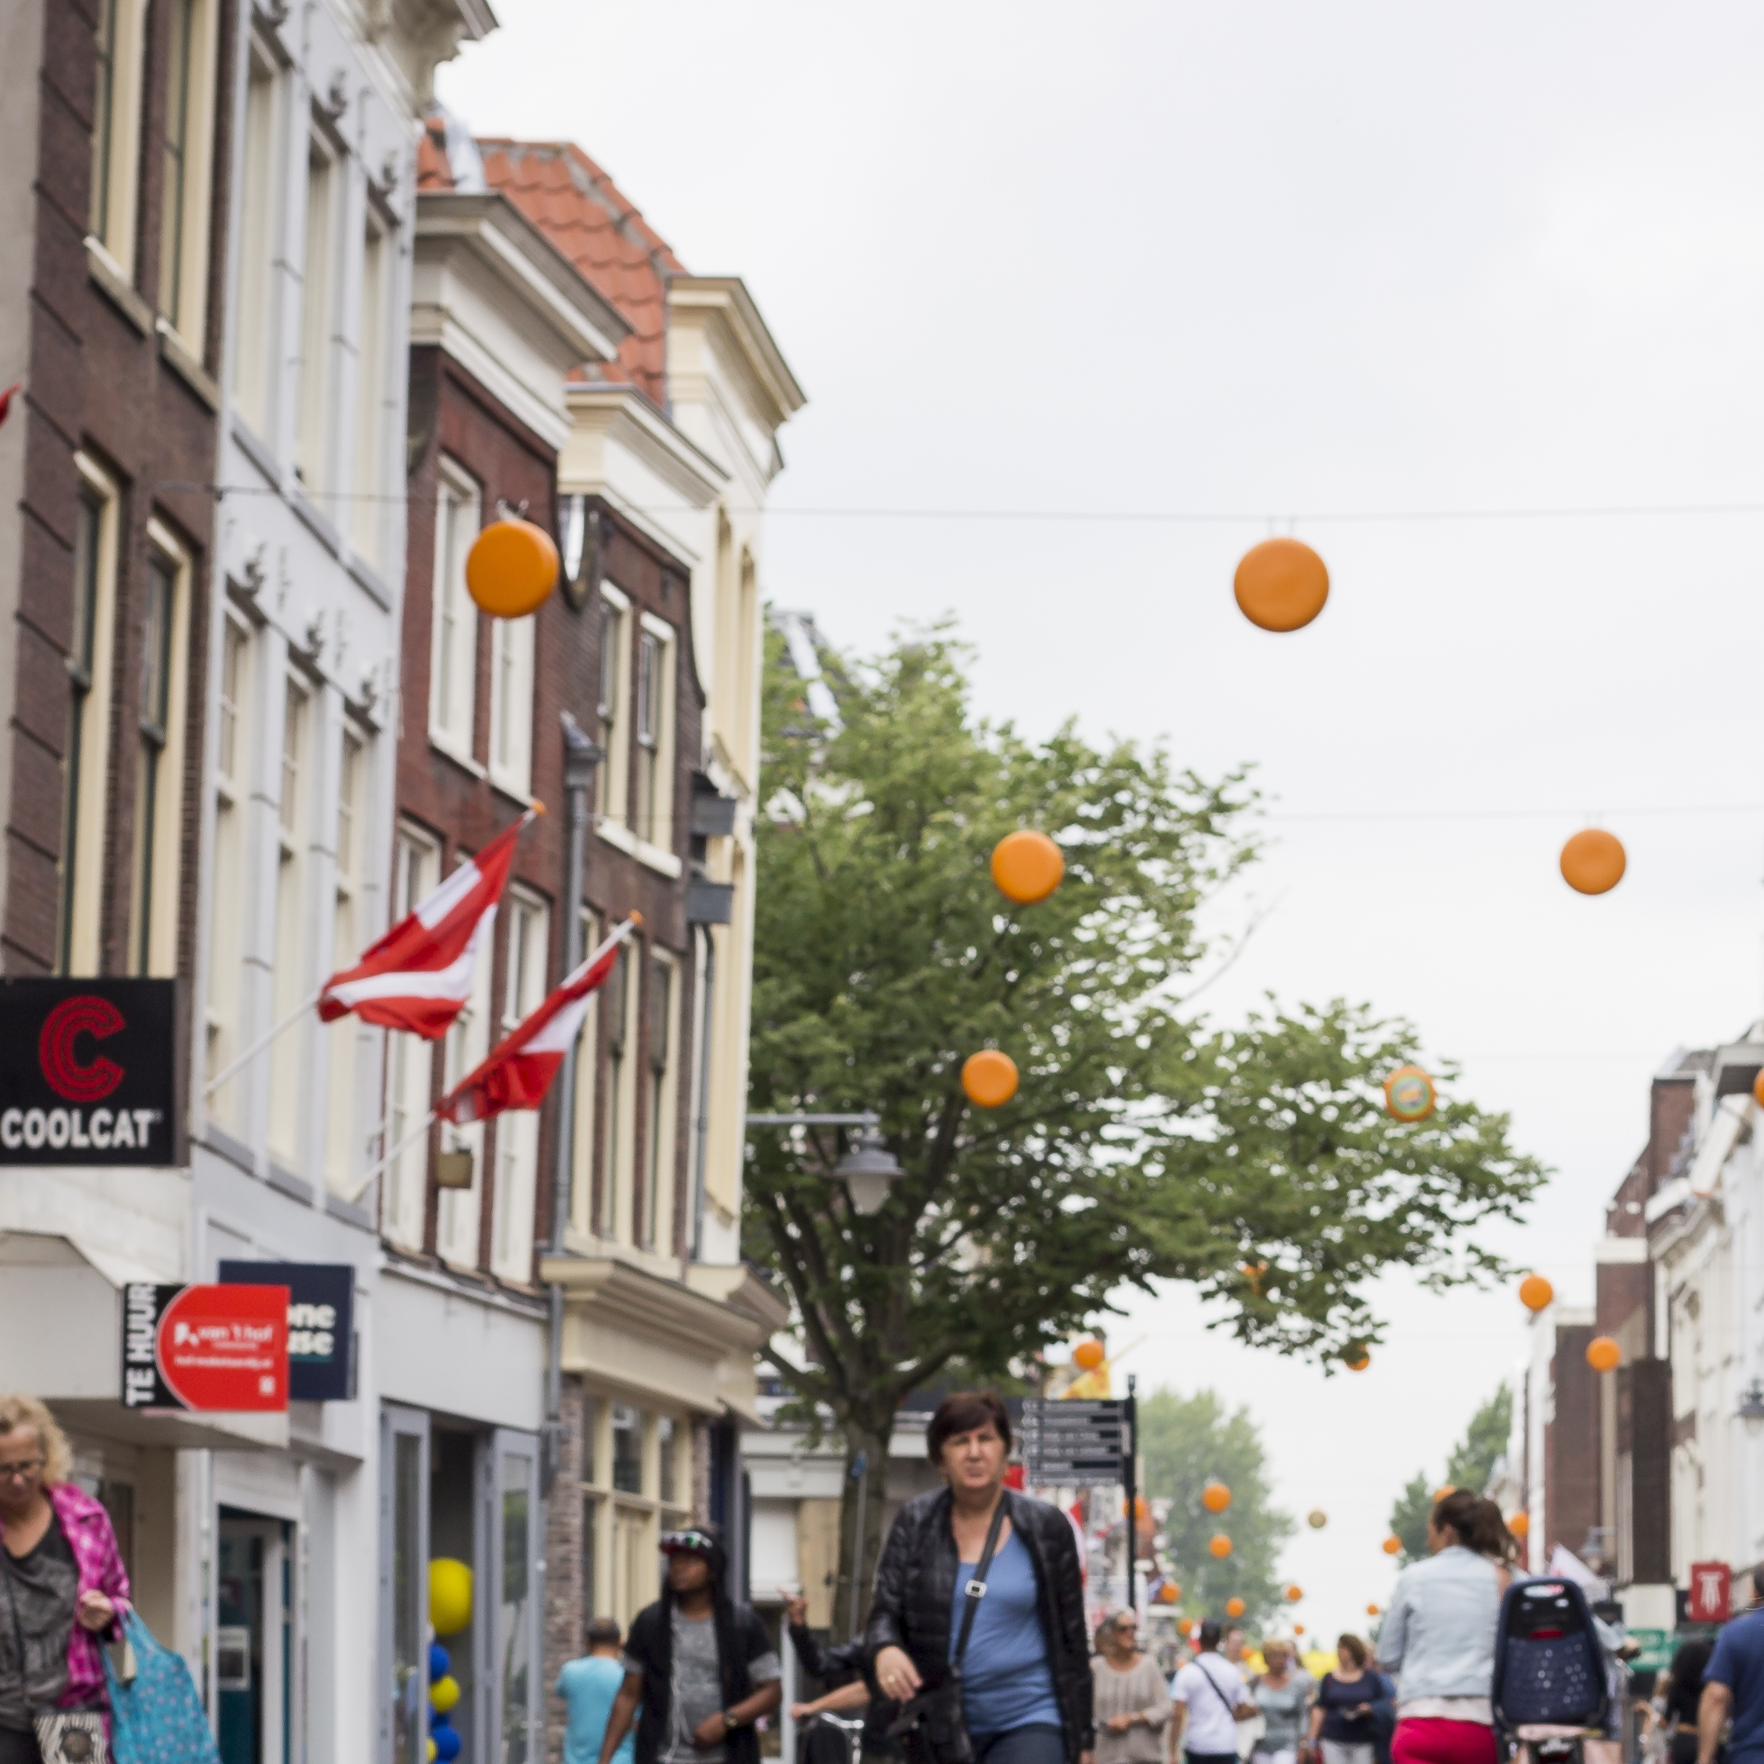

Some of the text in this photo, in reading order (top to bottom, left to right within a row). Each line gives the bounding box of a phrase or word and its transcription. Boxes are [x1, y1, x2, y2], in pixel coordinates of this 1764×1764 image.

[0, 1107, 155, 1149] COOLCAT
[126, 1284, 157, 1406] TE HUUR
